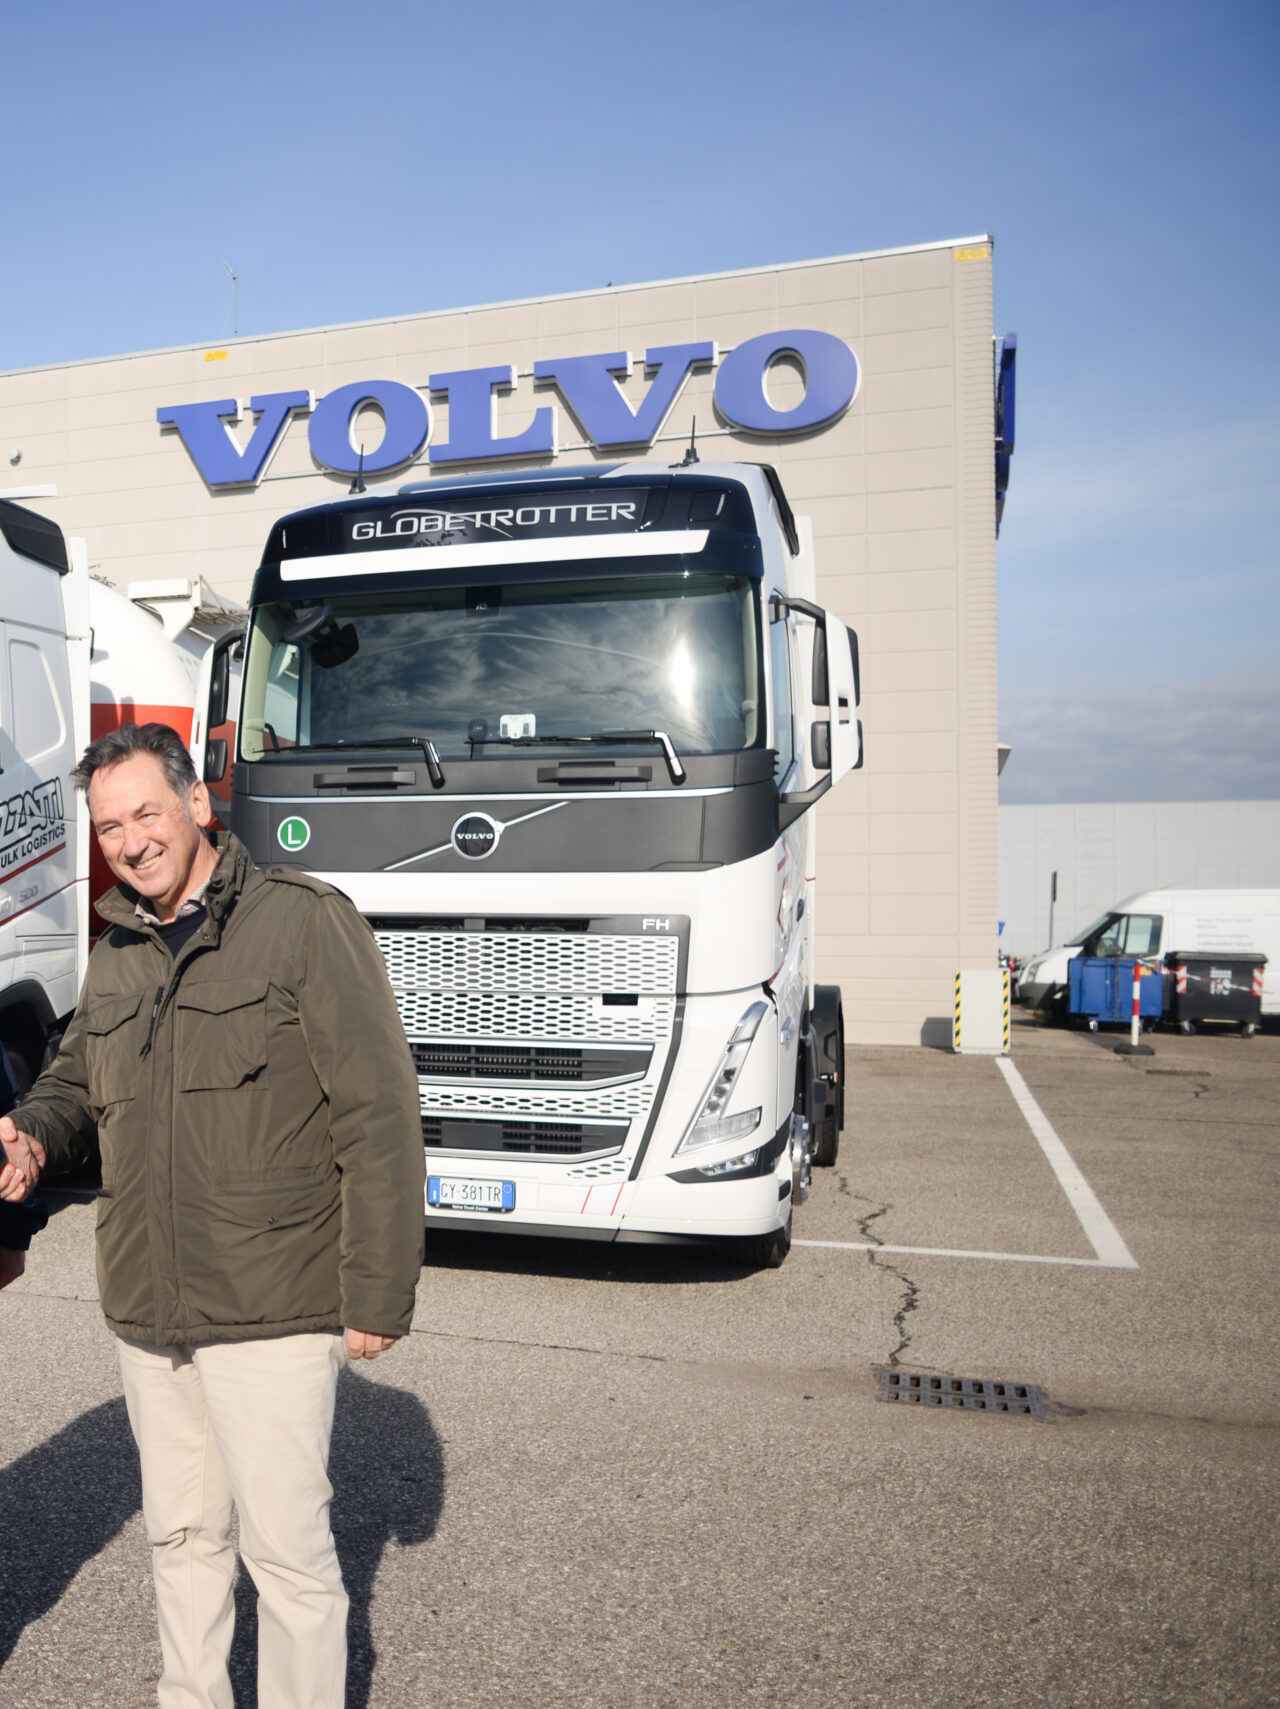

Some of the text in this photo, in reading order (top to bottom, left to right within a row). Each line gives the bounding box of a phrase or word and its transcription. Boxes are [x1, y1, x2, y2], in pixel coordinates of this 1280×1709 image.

[157, 329, 861, 488] VOLVO
[352, 502, 636, 540] GLOBETROTTER
[21, 823, 66, 857] LOGISTICS
[287, 823, 301, 844] L
[456, 832, 494, 840] VOLVO
[20, 885, 38, 903] 500
[642, 918, 670, 931] FH
